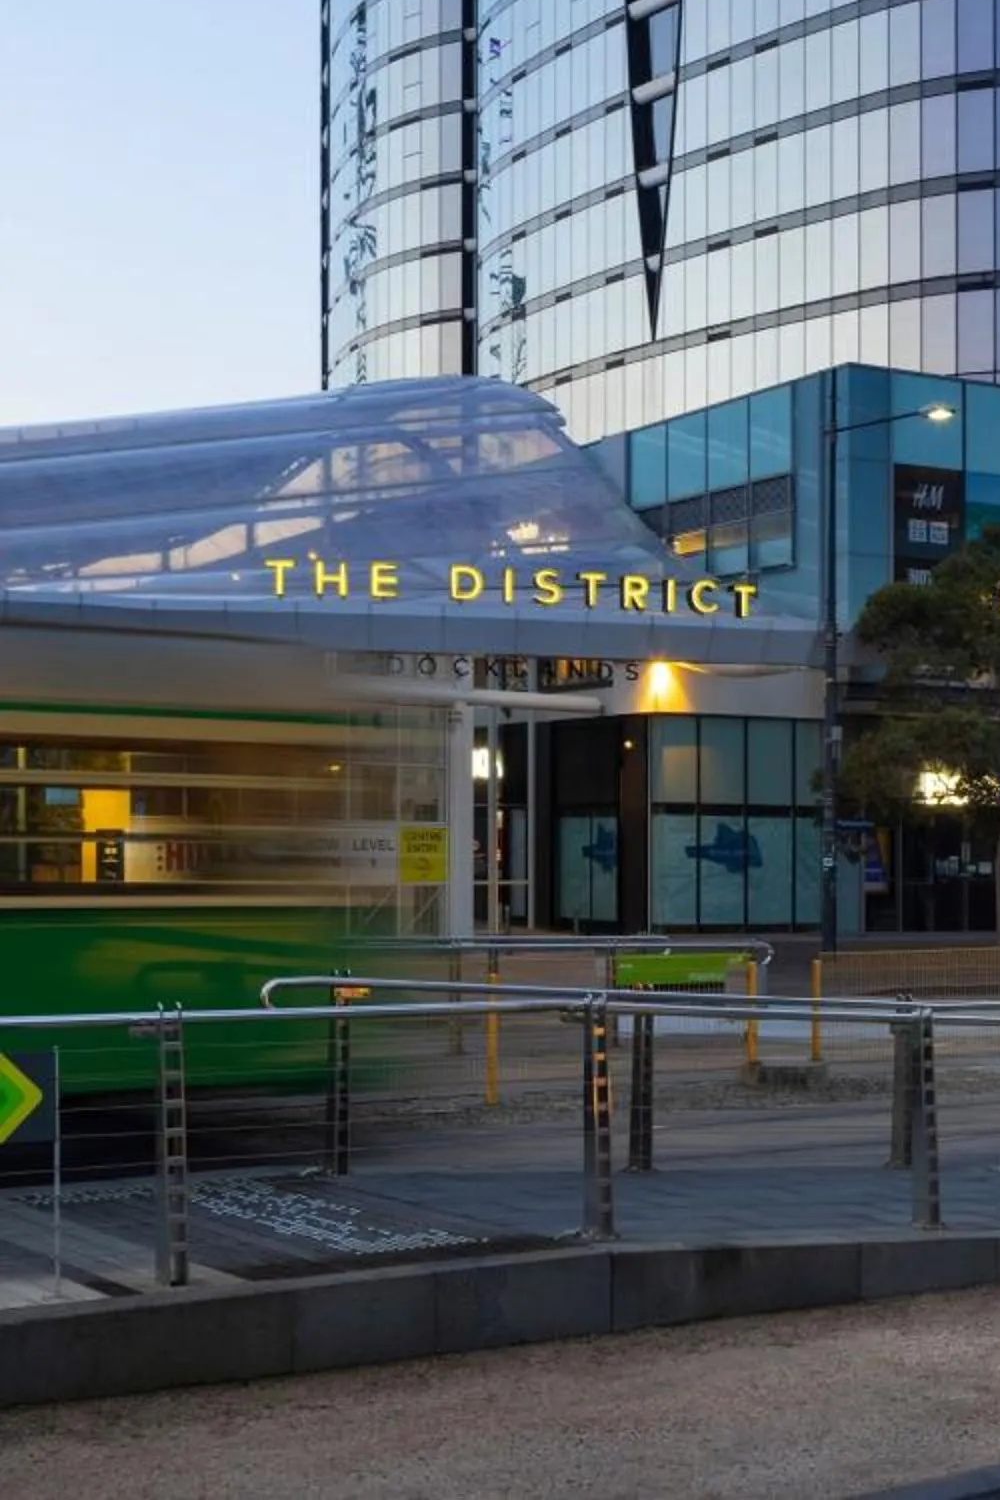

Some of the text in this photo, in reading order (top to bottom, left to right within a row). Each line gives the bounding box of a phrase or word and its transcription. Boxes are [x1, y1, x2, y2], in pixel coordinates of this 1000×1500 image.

[264, 559, 757, 619] THE DISTRICT
[351, 837, 395, 852] LEVEL
